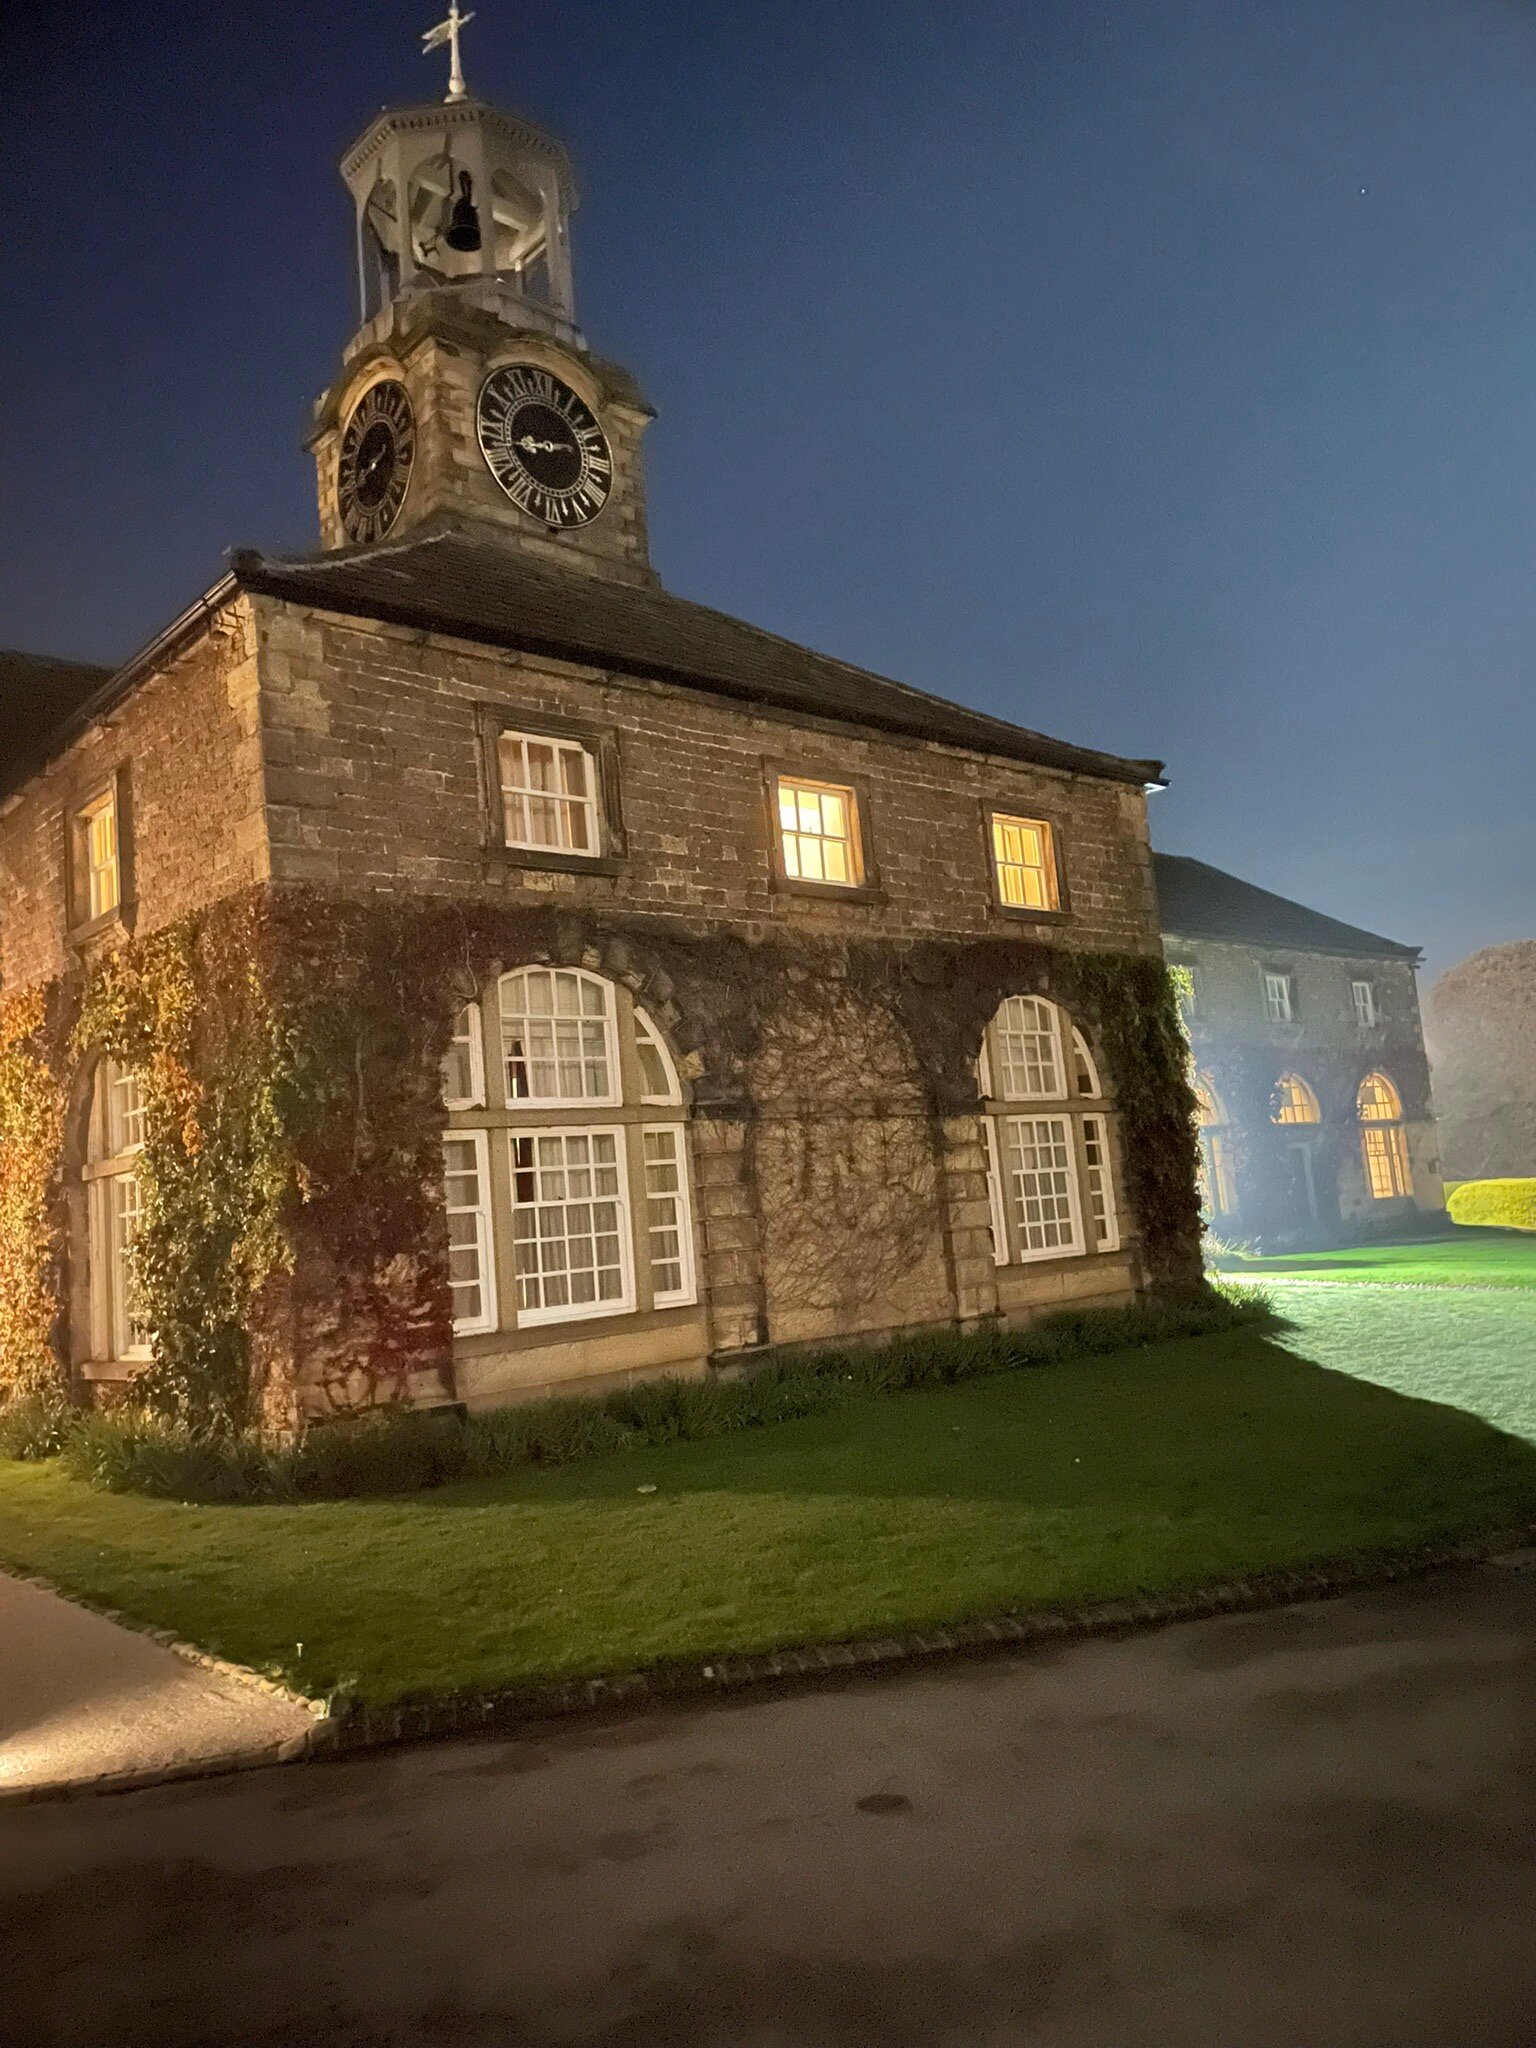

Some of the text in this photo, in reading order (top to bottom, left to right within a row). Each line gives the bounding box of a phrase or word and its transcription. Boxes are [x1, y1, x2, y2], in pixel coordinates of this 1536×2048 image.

[504, 369, 528, 397] XI
[532, 370, 554, 402] XII
[486, 384, 512, 413] X
[564, 394, 577, 415] I
[480, 414, 504, 441] IX
[486, 447, 514, 478] VIII
[589, 455, 611, 475] III
[508, 476, 534, 508] VII
[545, 496, 563, 524] VI
[571, 496, 588, 522] V
